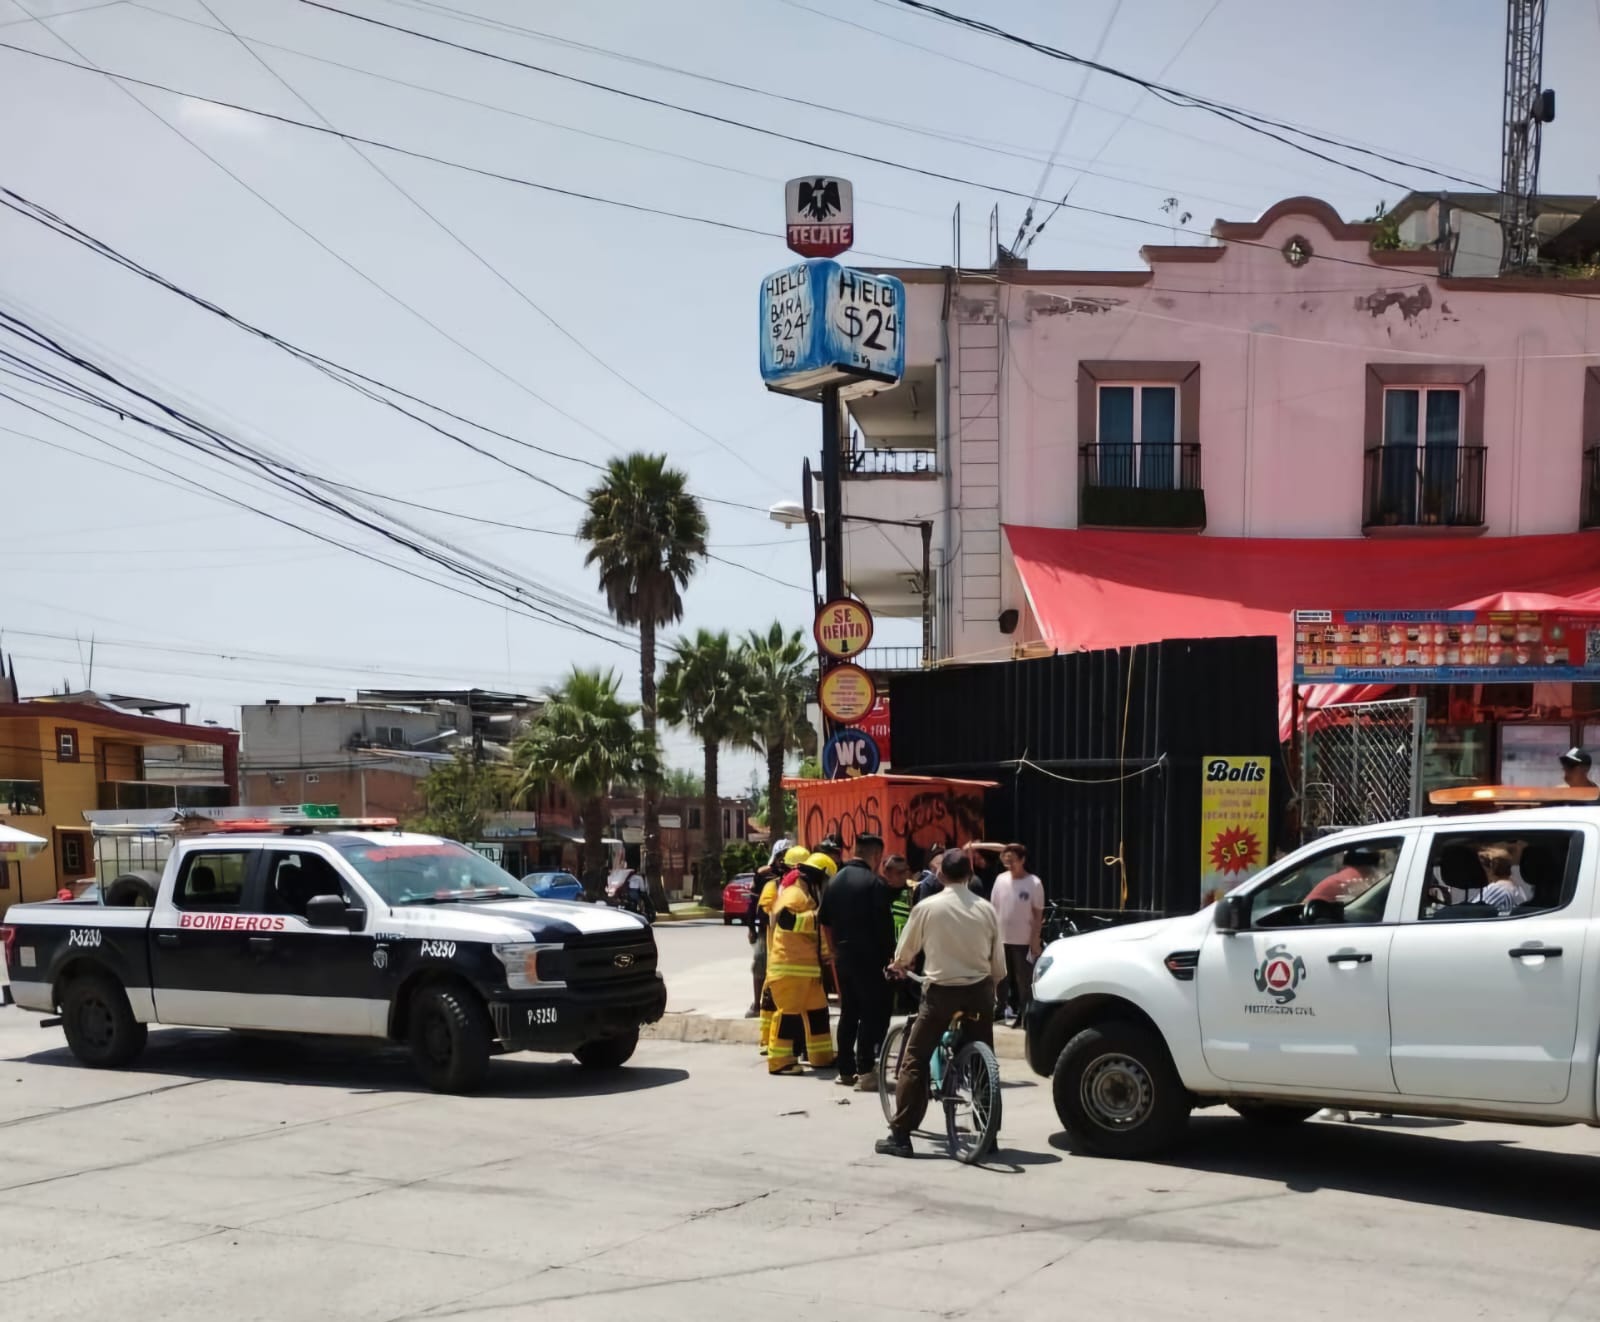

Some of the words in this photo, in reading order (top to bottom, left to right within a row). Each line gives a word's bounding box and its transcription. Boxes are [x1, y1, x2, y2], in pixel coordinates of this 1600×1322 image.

[789, 225, 850, 245] TECATE
[766, 263, 808, 298] HIELO
[839, 270, 896, 308] HIELO
[836, 306, 898, 353] $24
[834, 608, 852, 623] SE
[823, 623, 864, 640] RENTA
[835, 739, 868, 766] WC
[1206, 760, 1266, 782] Bolis
[180, 914, 286, 931] BOMBEROS
